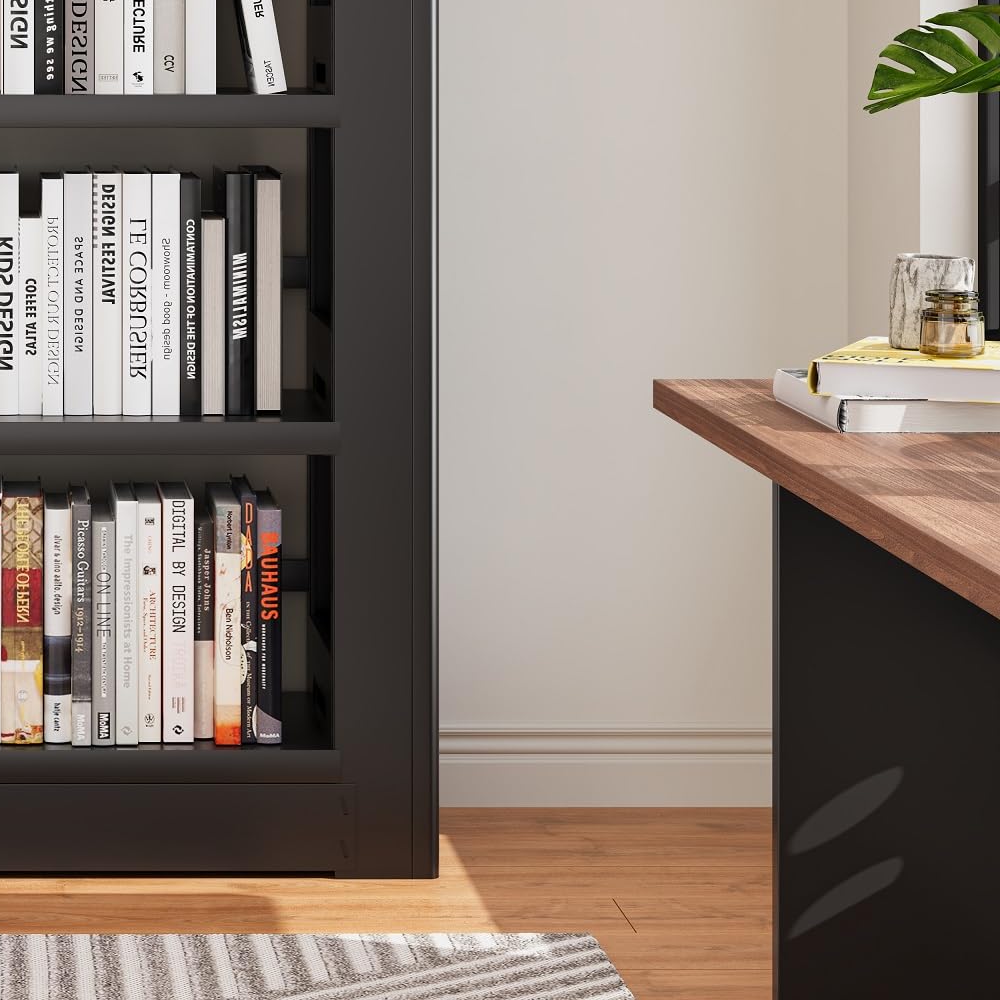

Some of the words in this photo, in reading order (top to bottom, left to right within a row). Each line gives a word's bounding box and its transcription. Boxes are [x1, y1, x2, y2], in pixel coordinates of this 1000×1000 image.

[77, 520, 89, 558] Picasso
[172, 500, 185, 552] DIGITAL
[124, 534, 133, 553] The
[172, 562, 185, 576] BY
[203, 549, 211, 580] Jasper
[260, 533, 280, 620] BAUHAUS
[77, 561, 89, 602] Guitars
[97, 572, 111, 594] ON
[122, 559, 133, 639] Impressionists
[172, 586, 186, 632] DESIGN
[97, 602, 111, 637] LINE
[225, 608, 233, 622] Ben
[123, 642, 132, 653] at
[122, 657, 132, 688] Home
[76, 714, 85, 740] MoMA
[99, 713, 109, 739] MoMA
